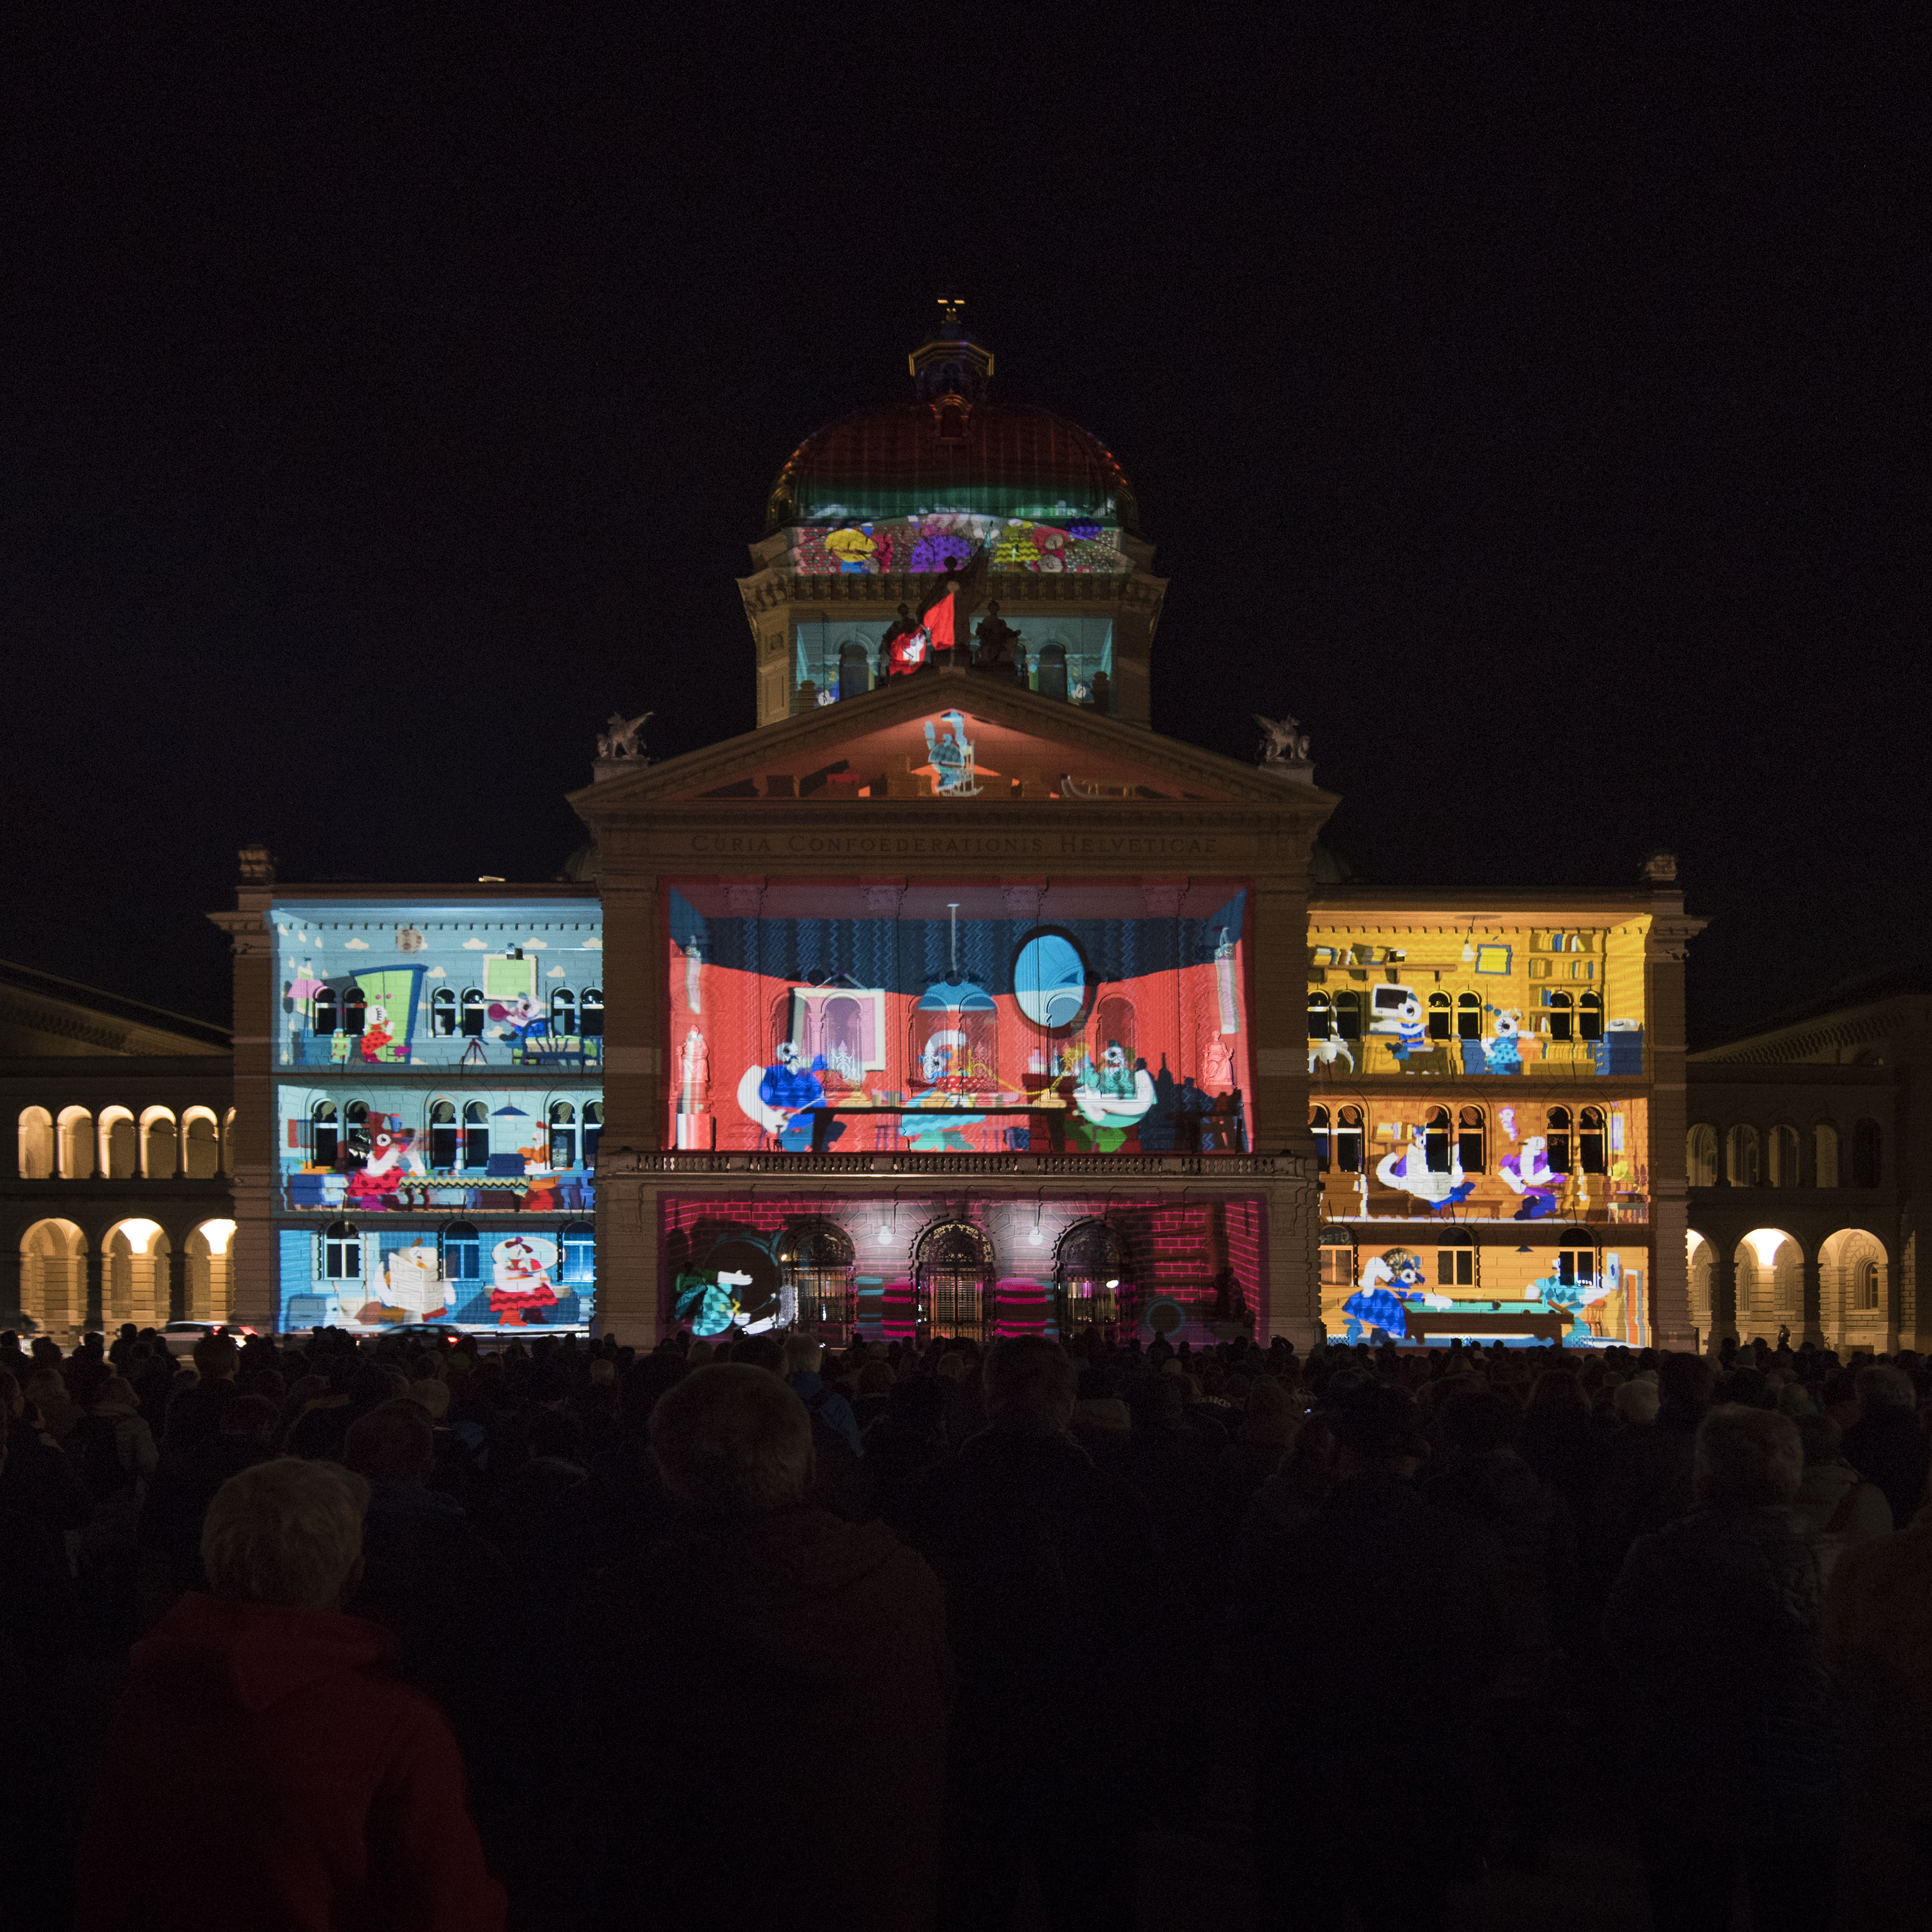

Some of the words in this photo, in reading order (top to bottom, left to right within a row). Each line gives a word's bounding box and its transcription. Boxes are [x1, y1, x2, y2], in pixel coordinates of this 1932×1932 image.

[691, 834, 771, 852] CURIA
[788, 835, 1042, 853] CONFOEDERATIONIS
[1061, 834, 1217, 853] HELVETICAE
